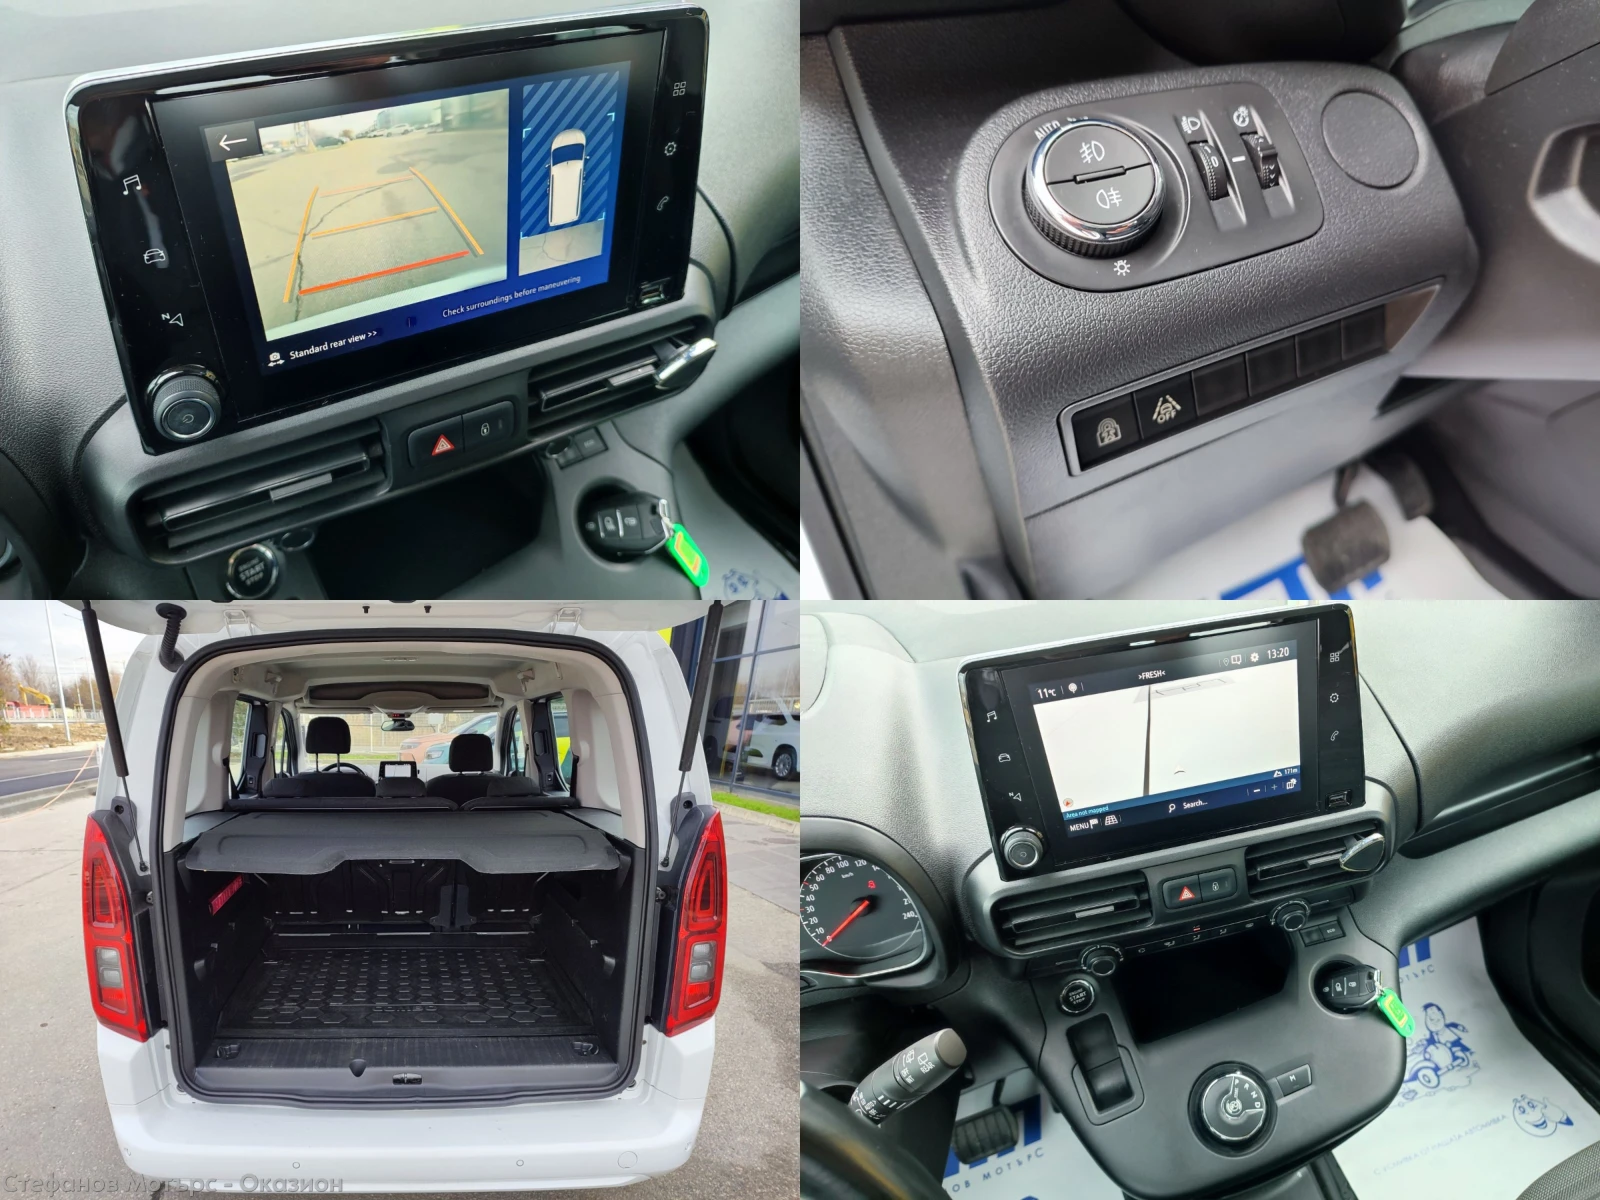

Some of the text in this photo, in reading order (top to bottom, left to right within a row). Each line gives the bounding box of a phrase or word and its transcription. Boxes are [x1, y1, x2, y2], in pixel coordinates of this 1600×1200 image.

[442, 275, 582, 318] Check surroundings before maneuvering
[289, 341, 329, 360] Standard
[329, 338, 347, 349] rear
[347, 333, 367, 344] view
[1156, 409, 1177, 424] OFF
[1267, 646, 1290, 660] 13:20
[1284, 767, 1298, 775] 171m
[1066, 805, 1110, 819] Area not mapped
[1069, 821, 1090, 832] MENU
[836, 859, 850, 869] 100
[854, 859, 868, 868] 120
[825, 865, 835, 875] 80
[841, 871, 854, 879] km/h
[815, 873, 825, 882] 60
[809, 883, 819, 892] 50
[805, 893, 815, 902] 40
[805, 905, 815, 914] 30
[902, 910, 915, 920] 240
[808, 916, 819, 925] 20
[815, 926, 825, 935] 10
[1069, 990, 1087, 1002] START
[1250, 1091, 1258, 1099] N
[982, 1147, 1044, 1181] МОТЪРС
